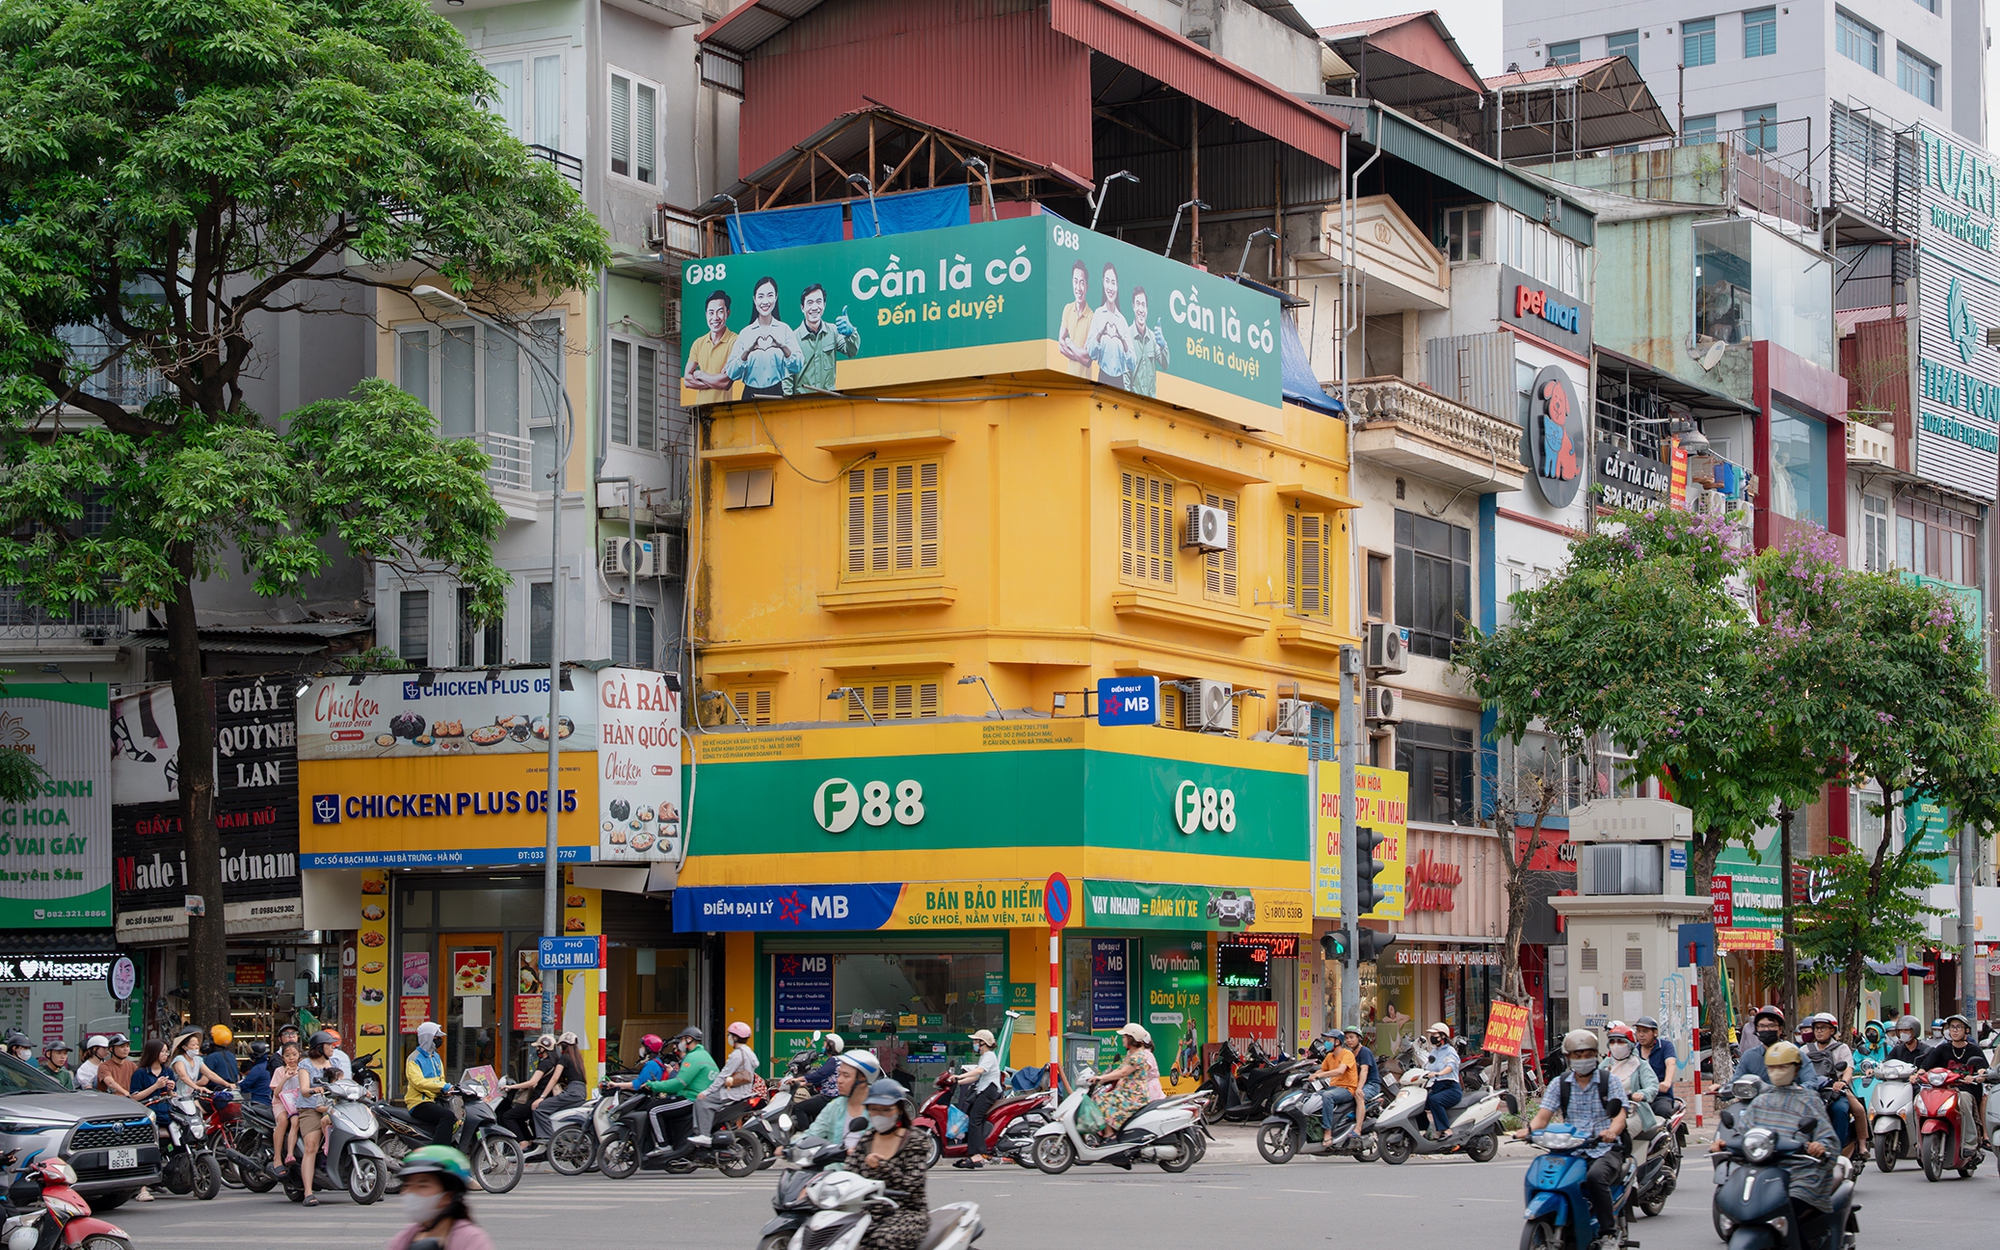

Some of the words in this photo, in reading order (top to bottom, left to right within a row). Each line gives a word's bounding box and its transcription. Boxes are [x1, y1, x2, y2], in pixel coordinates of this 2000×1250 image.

[1931, 204, 1948, 231] 160
[851, 254, 926, 301] Cần
[939, 253, 978, 290] là
[986, 244, 1033, 284] có
[877, 304, 910, 328] Đến
[914, 300, 937, 324] là
[941, 293, 1006, 322] duyệt
[1168, 284, 1216, 333] Cần
[1221, 304, 1243, 342] là
[1246, 318, 1275, 356] có
[1515, 284, 1580, 335] petmart
[1186, 336, 1211, 364] Đến
[1212, 344, 1227, 367] là
[1230, 348, 1260, 379] duyệt
[1922, 357, 1961, 408] THAI
[1605, 450, 1626, 480] CẮT
[1643, 466, 1669, 493] LÔNG
[1602, 484, 1623, 508] SPA
[1624, 490, 1644, 514] CHÓ
[228, 675, 283, 714] GIẦY
[423, 679, 488, 697] CHICKEN
[491, 678, 530, 695] PLUS
[601, 673, 632, 710] GÀ
[636, 676, 678, 713] RÁN
[315, 682, 379, 723] Chicken
[1124, 696, 1150, 712] MB
[218, 717, 296, 758] QUỲNH
[603, 718, 635, 745] HÀN
[638, 718, 679, 750] QUỐC
[236, 761, 281, 789] LAN
[605, 751, 642, 781] Chicken
[44, 780, 93, 797] SINH
[346, 792, 453, 819] CHICKEN
[457, 790, 522, 816] PLUS
[813, 777, 926, 834] F88
[1174, 779, 1237, 835] F88
[1378, 799, 1386, 824] IN
[1388, 795, 1406, 826] MÀU
[23, 808, 70, 826] HOA
[136, 813, 172, 836] GIẦY
[252, 805, 277, 826] NỮ
[15, 838, 45, 856] VAI
[50, 832, 88, 856] GÁY
[531, 851, 544, 859] 033
[117, 852, 176, 892] Made
[219, 846, 297, 884] ietnam
[327, 855, 338, 864] SỐ
[344, 855, 364, 866] BẠCH
[364, 855, 379, 863] MAI
[383, 854, 396, 863] HAI
[397, 853, 407, 862] BÀ
[408, 853, 433, 862] TRƯNG
[437, 852, 448, 861] HÀ
[449, 851, 463, 863] NỘI
[1420, 849, 1463, 885] Venus
[53, 867, 84, 882] Sâu
[703, 899, 734, 916] ĐIỂM
[736, 902, 758, 918] ĐẠI
[760, 898, 774, 914] LÝ
[811, 895, 850, 920] MB
[926, 887, 959, 911] BÁN
[964, 884, 997, 910] BẢO
[1002, 882, 1043, 909] HIỂM
[1092, 896, 1109, 915] VAY
[1110, 897, 1140, 916] NHANH
[1150, 896, 1173, 916] ĐĂNG
[1175, 898, 1186, 917] KÝ
[1187, 900, 1199, 918] XE
[1713, 904, 1725, 913] XE
[908, 912, 930, 925] SỨC
[965, 910, 990, 924] NẰM
[992, 912, 1019, 926] VIỆN,
[1021, 913, 1035, 923] TAI
[1271, 907, 1285, 918] 1800
[565, 938, 584, 948] PHỐ
[544, 953, 572, 967] BẠCH
[573, 952, 594, 964] MAI
[801, 957, 827, 973] MB
[1107, 955, 1123, 971] MB
[1150, 954, 1169, 974] Vay
[1170, 956, 1200, 971] nhanh
[1398, 949, 1409, 964] ĐỒ
[38, 960, 109, 980] Massage
[1014, 987, 1027, 998] 02
[1150, 989, 1175, 1010] Đăng
[1176, 989, 1187, 1008] ký
[1189, 993, 1201, 1005] xe
[1229, 1004, 1277, 1027] PHOTO-IN
[1490, 1002, 1511, 1019] PHOTO
[1511, 1007, 1529, 1022] COPY
[1101, 1035, 1119, 1047] NNX
[1487, 1020, 1508, 1041] CHỤP
[1507, 1021, 1524, 1042] ẢNH
